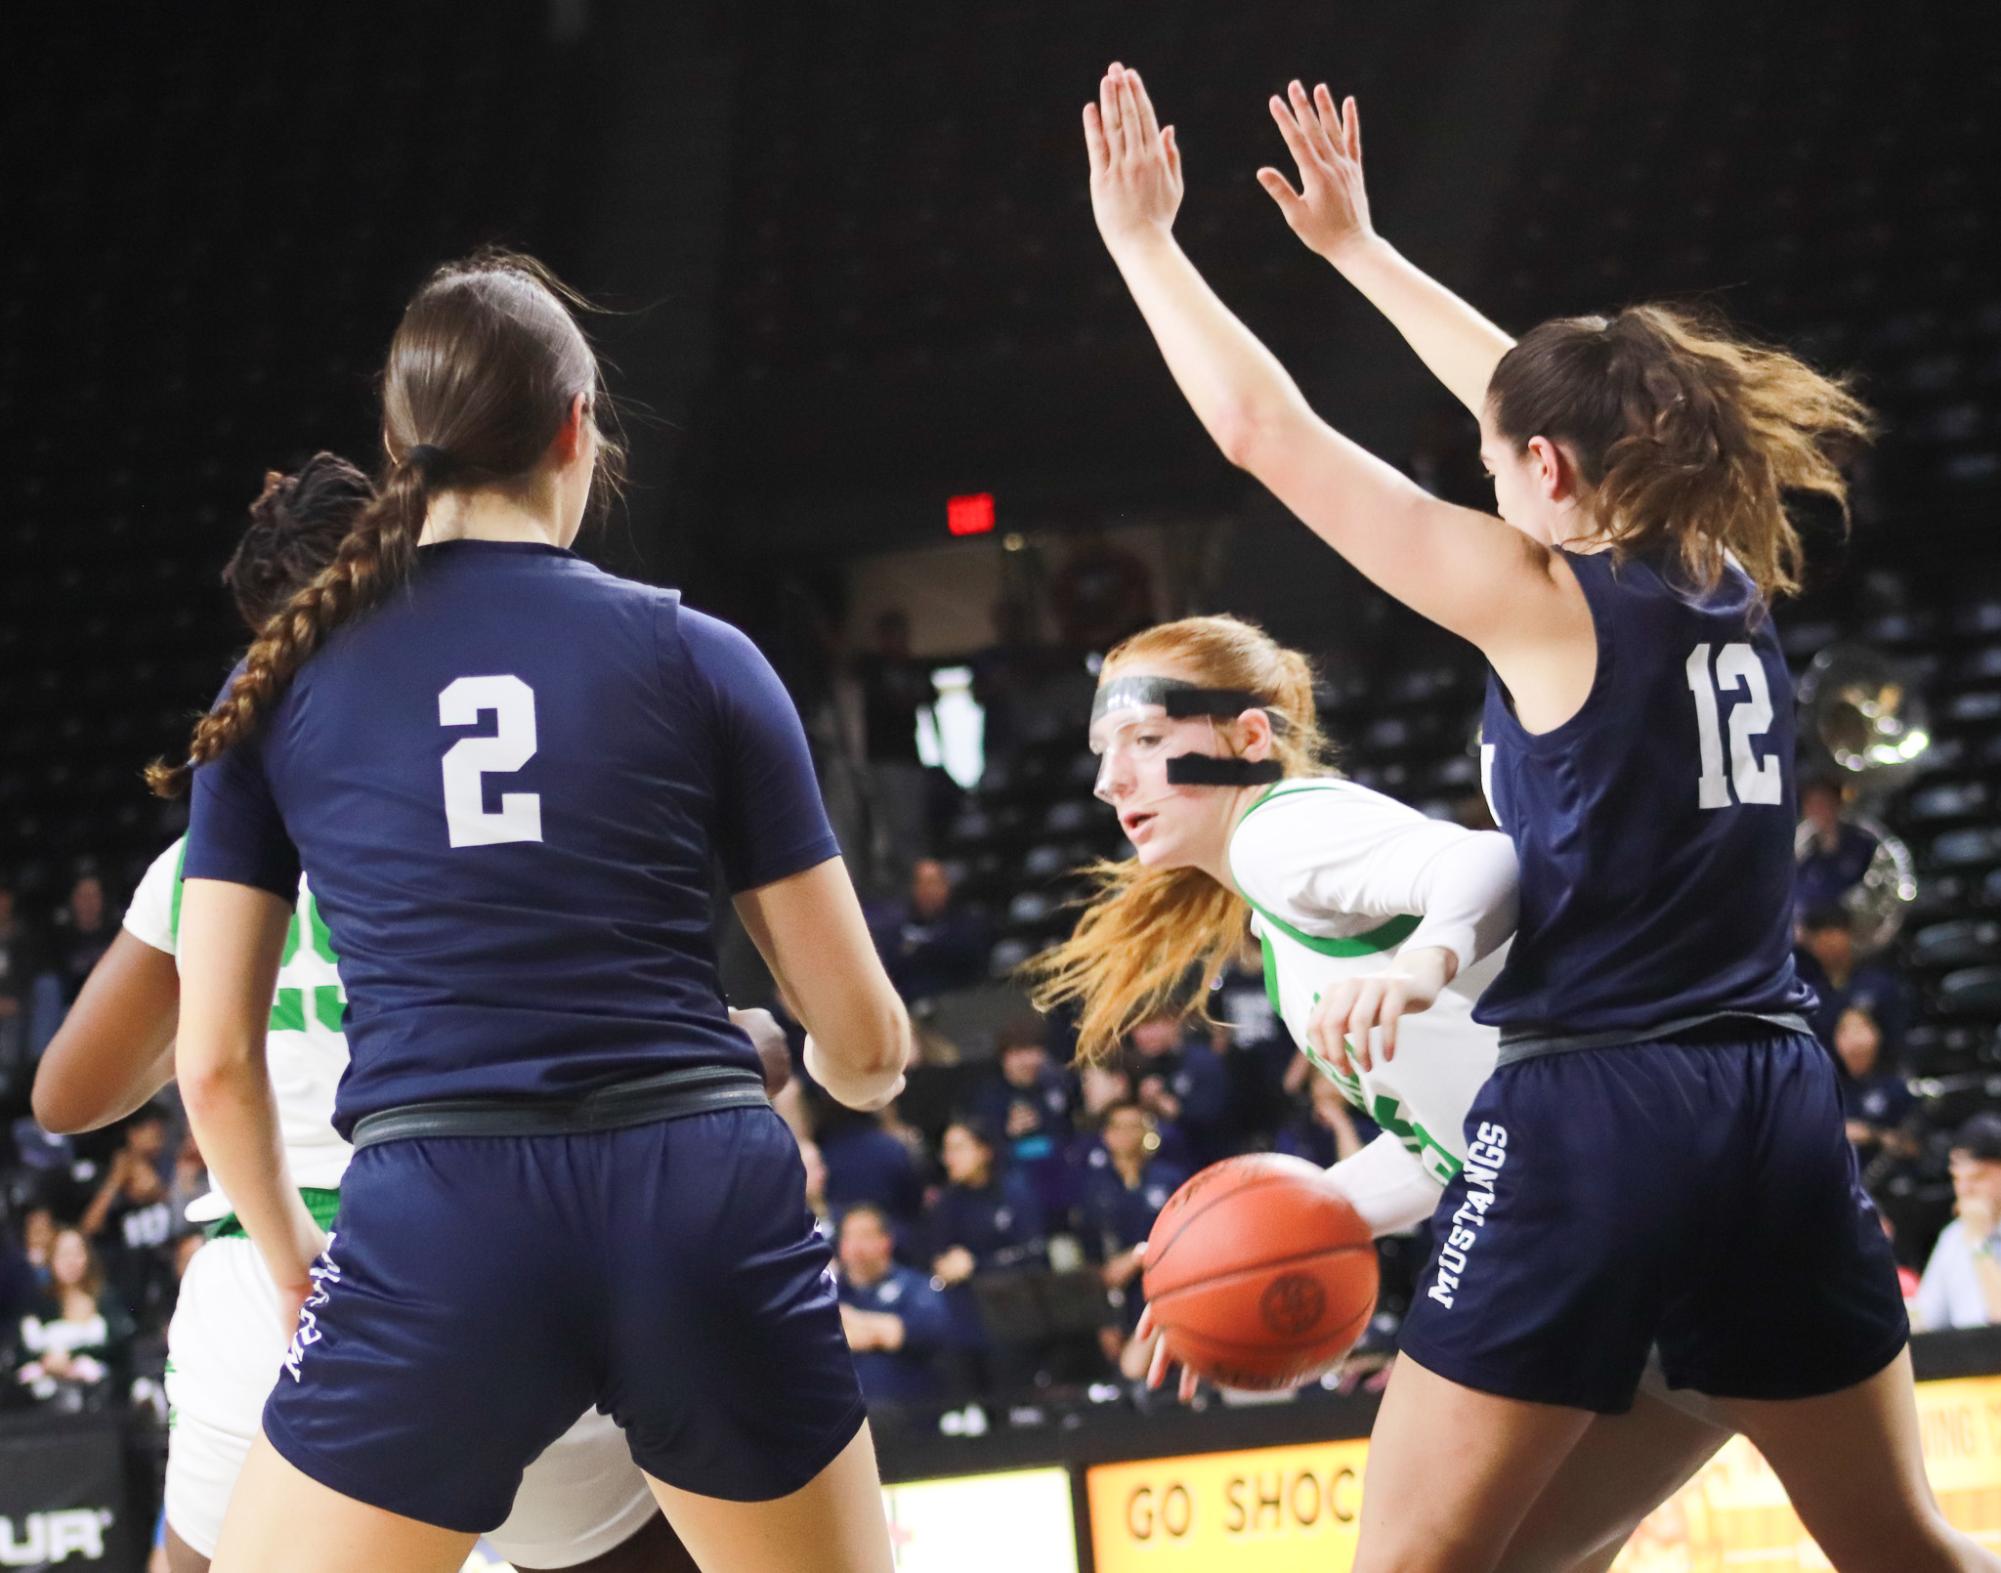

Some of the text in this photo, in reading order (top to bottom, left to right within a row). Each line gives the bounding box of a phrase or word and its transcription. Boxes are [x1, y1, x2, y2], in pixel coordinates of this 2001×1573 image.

[438, 674, 544, 848] 2
[1686, 643, 1782, 809] 12
[1428, 1121, 1508, 1310] MUSTANGS
[1127, 1483, 1190, 1541] GO
